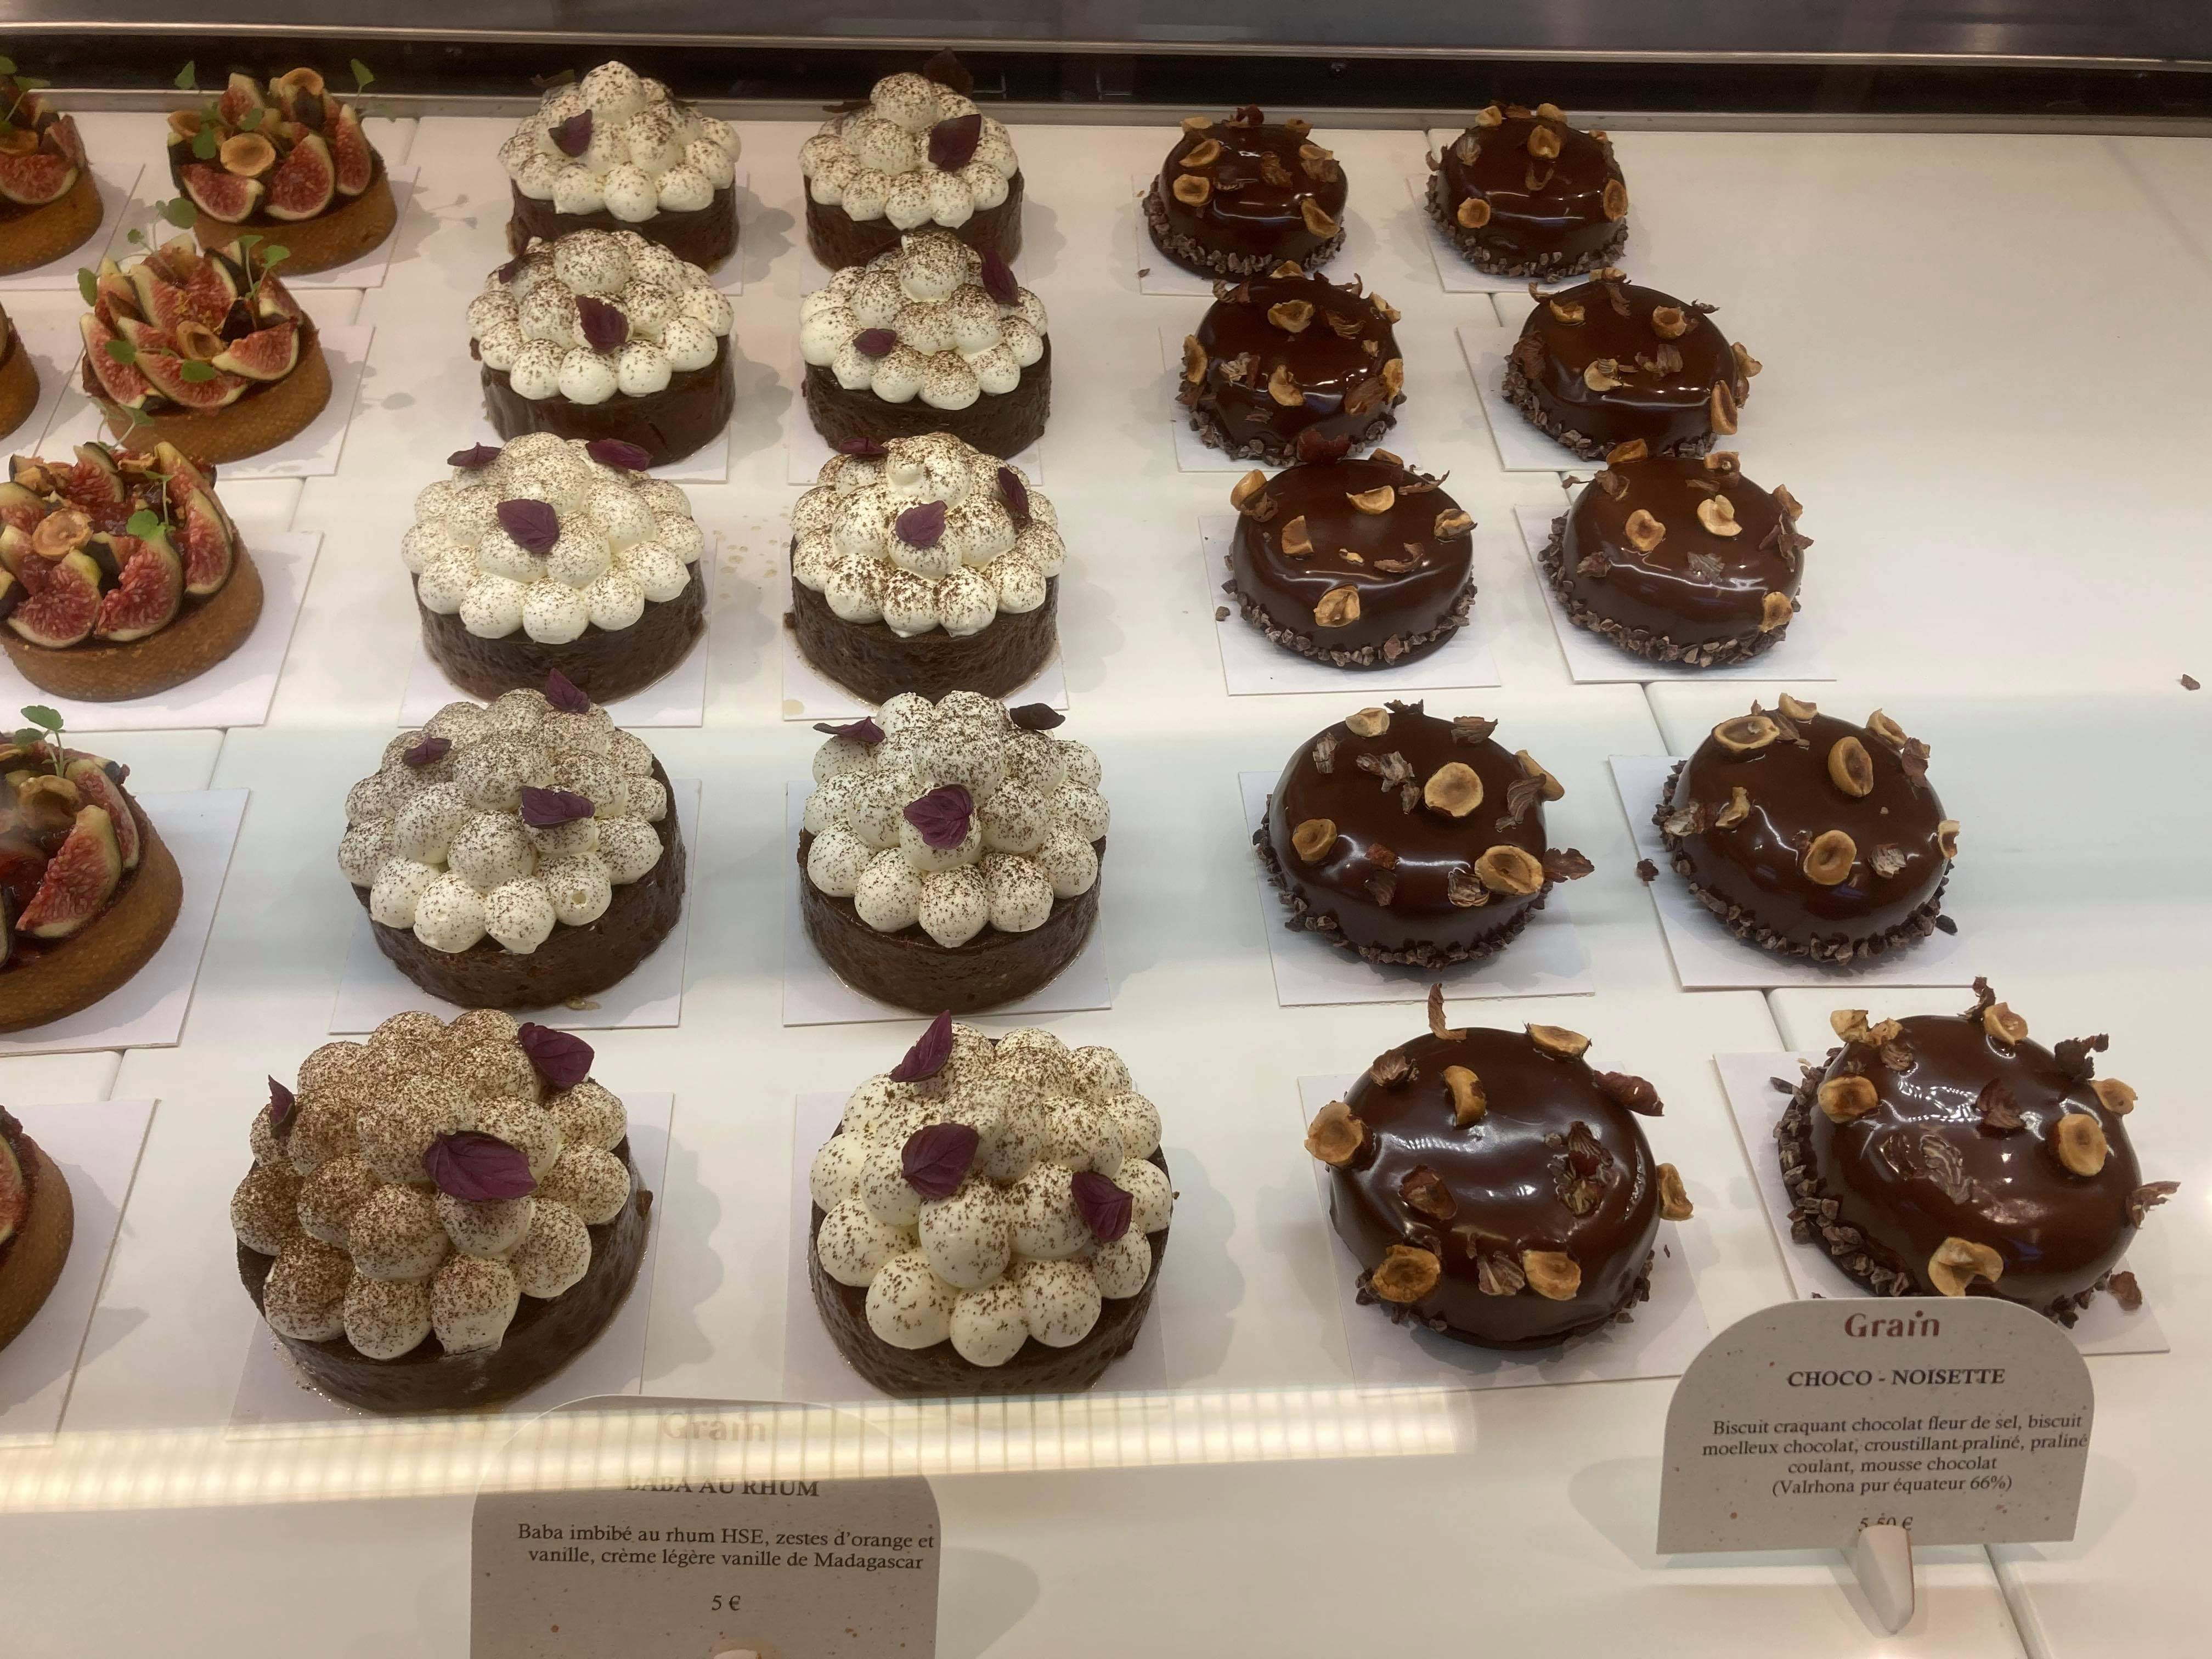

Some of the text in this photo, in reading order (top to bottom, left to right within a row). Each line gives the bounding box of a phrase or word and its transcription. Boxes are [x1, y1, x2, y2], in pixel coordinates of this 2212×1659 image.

[1844, 1310, 1940, 1338] Grain
[1786, 1370, 1873, 1388] CHOCO
[1891, 1368, 2006, 1386] NOISETTE
[662, 1412, 766, 1442] Grain
[1713, 1414, 2082, 1436] Biscuit craquant chocolat fleur de sel, biscuit
[1702, 1432, 2088, 1457] moelleux chocolat, croustillant praliné, praliné
[1787, 1455, 1997, 1476] coulant, mousse chocolat
[625, 1476, 820, 1497] BABA AU RHUM
[1772, 1475, 2012, 1498] (Valrhona pur équateur 66%)
[518, 1523, 563, 1540] Baba
[569, 1523, 633, 1542] imbibé
[637, 1529, 659, 1542] au
[665, 1528, 716, 1544] rhum
[721, 1528, 771, 1547] HSE,
[775, 1532, 828, 1546] zestes
[918, 1535, 935, 1548] et
[528, 1546, 924, 1571] vanille, crème légère vanille de Madagascar
[711, 1595, 741, 1612] 5 €
